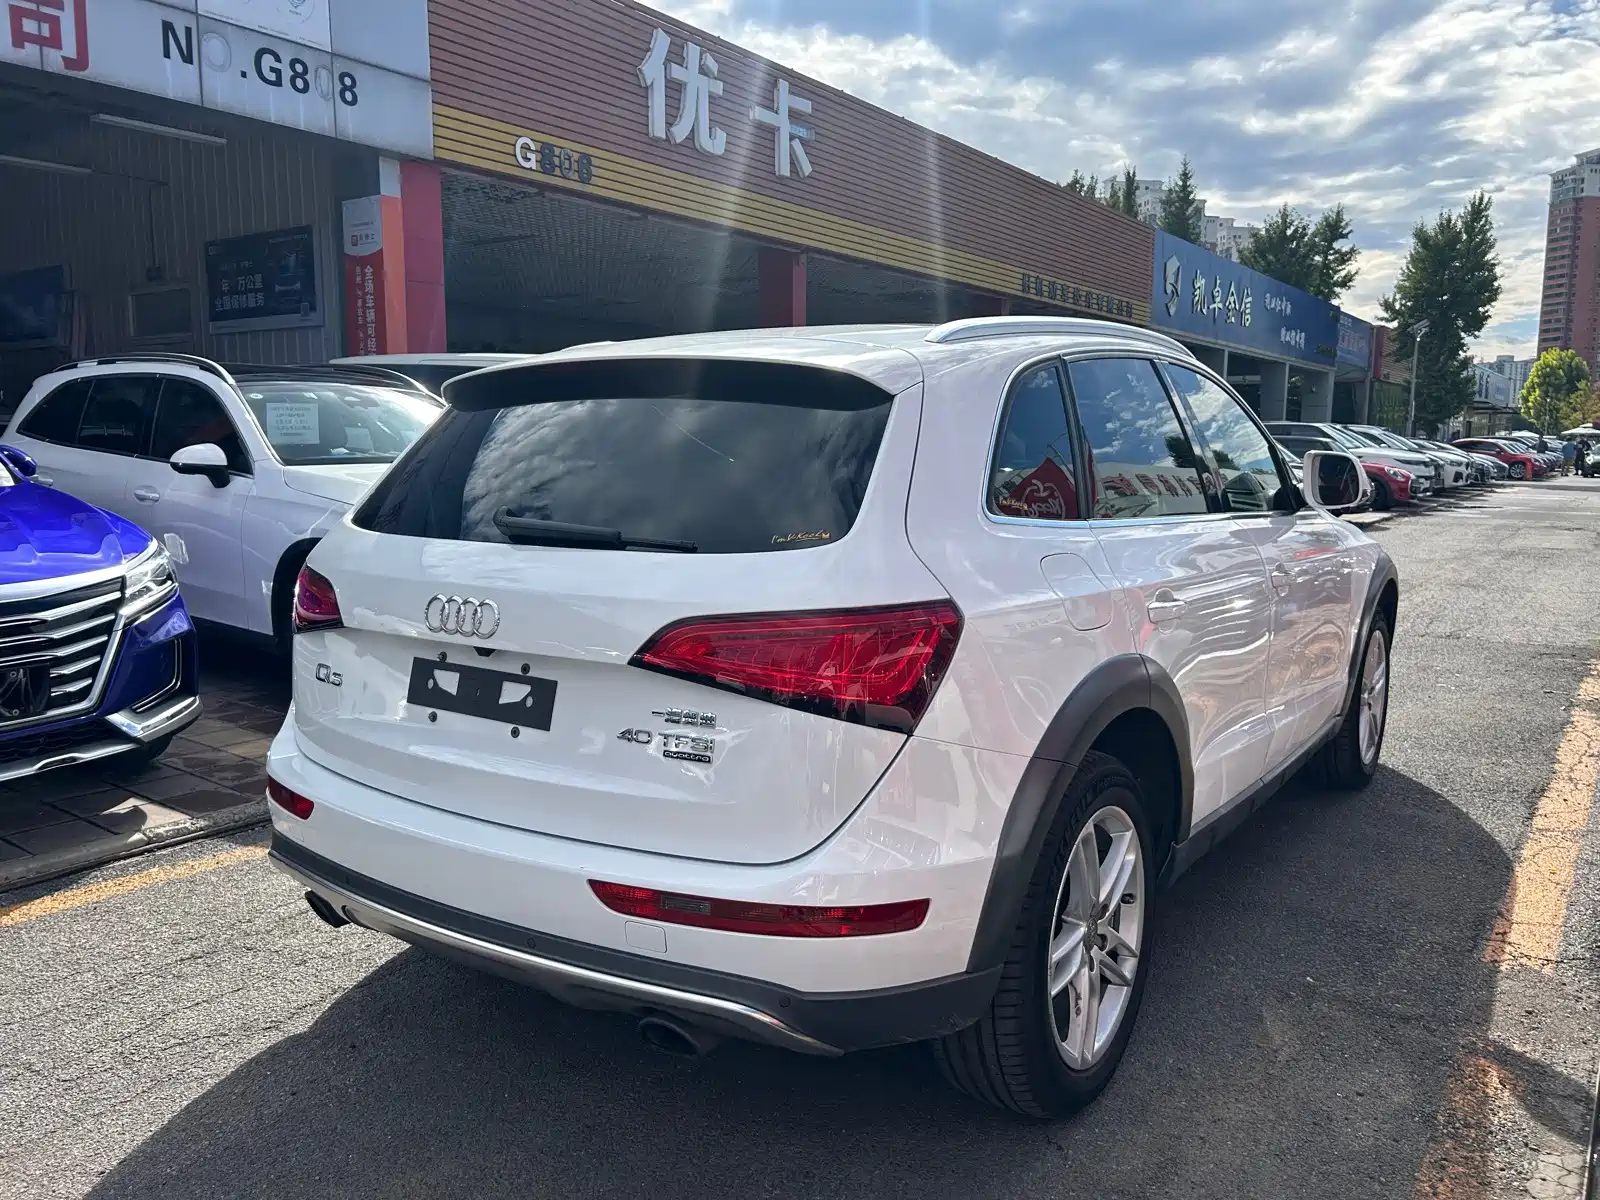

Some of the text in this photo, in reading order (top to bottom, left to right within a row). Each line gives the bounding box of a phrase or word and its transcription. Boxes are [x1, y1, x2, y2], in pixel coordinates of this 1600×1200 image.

[637, 27, 813, 179] 优卡
[1192, 269, 1253, 327] 凯卓金信
[315, 662, 343, 687] Q5
[616, 727, 715, 754] 40 TFSI
[663, 750, 713, 764] quattro
